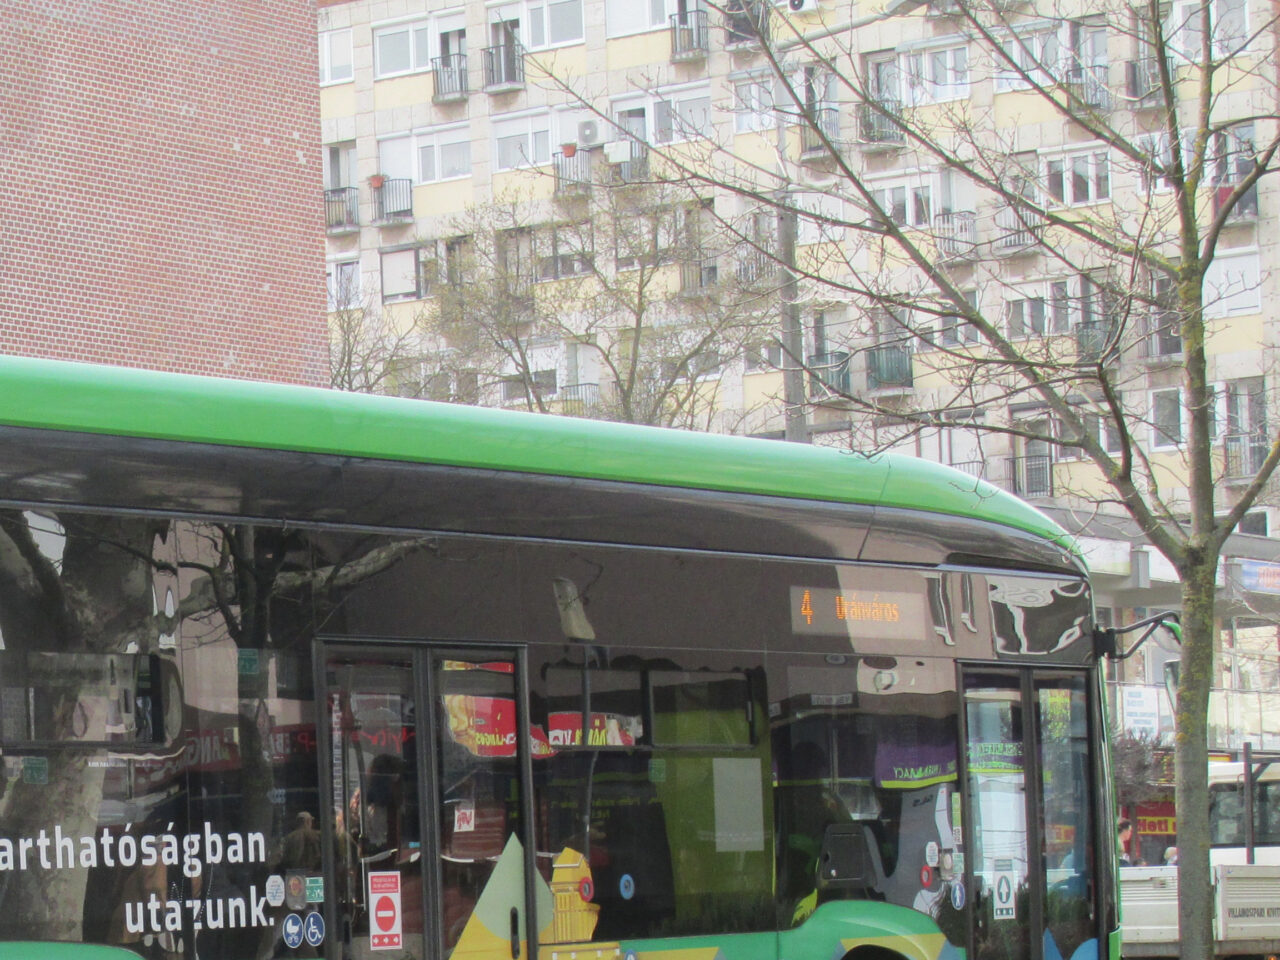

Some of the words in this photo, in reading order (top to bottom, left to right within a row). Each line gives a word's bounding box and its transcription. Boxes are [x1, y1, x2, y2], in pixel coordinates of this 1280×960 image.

[801, 590, 814, 625] 4
[835, 592, 899, 622] Uránváros
[124, 886, 275, 933] utazunk.
